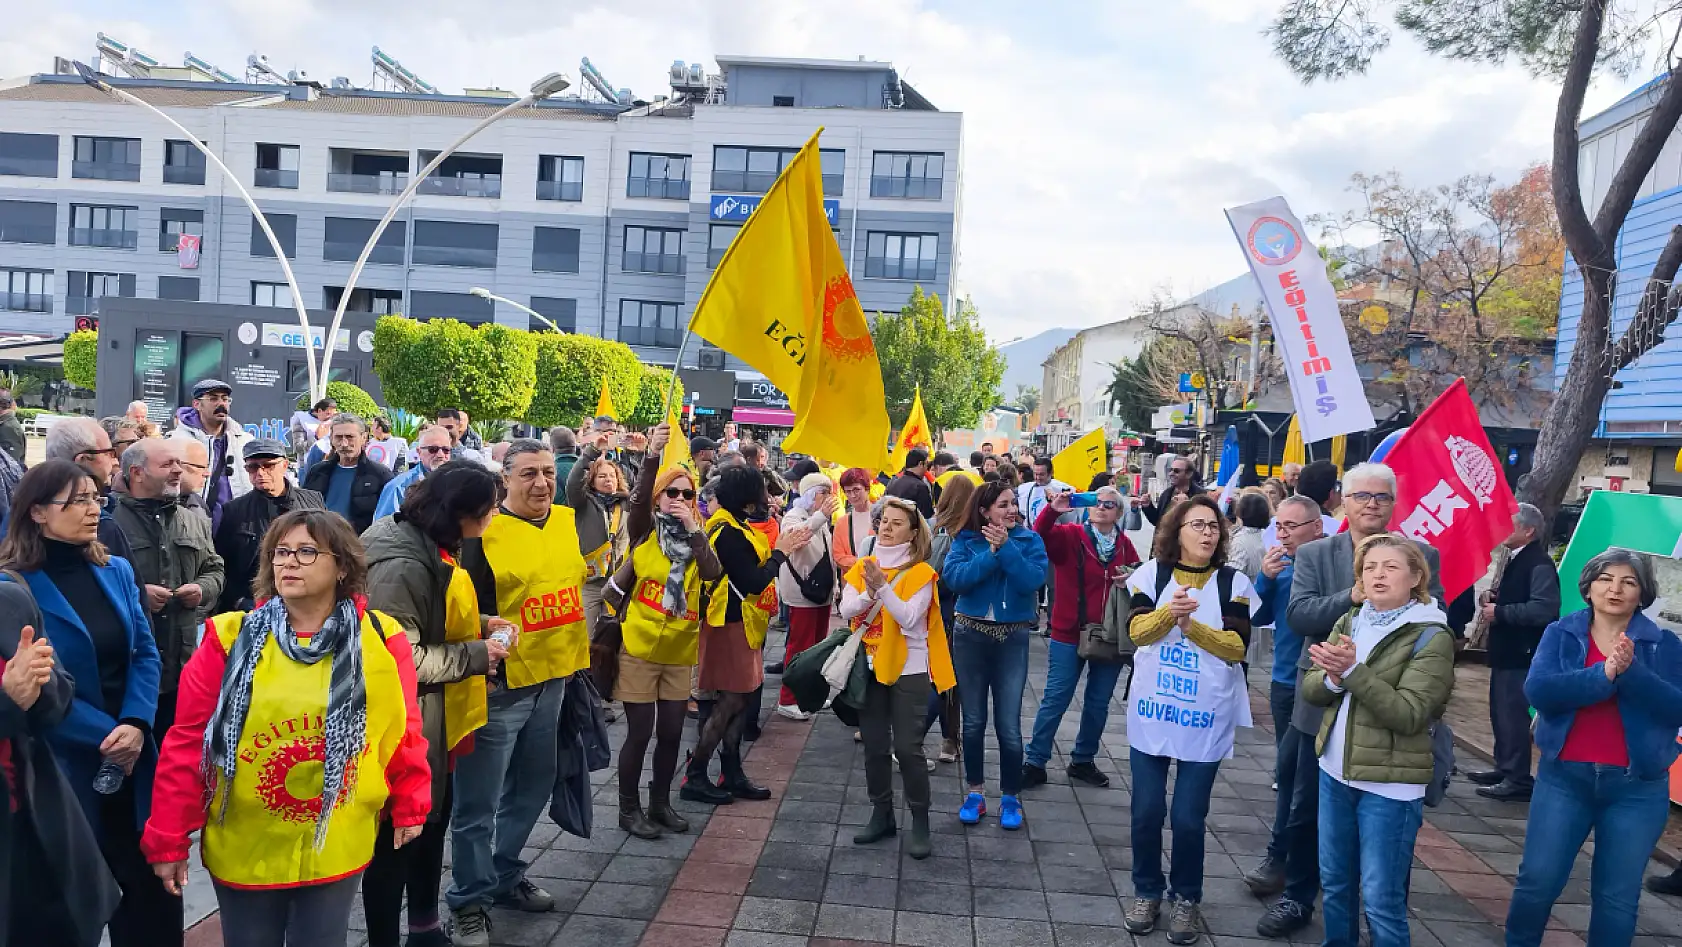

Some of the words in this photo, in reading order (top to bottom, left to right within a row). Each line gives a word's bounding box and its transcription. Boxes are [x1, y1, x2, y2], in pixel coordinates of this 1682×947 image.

[282, 333, 323, 347] GEA
[752, 383, 776, 396] FOR
[522, 585, 584, 624] GREV
[1137, 696, 1216, 728] GÜVENCESİ
